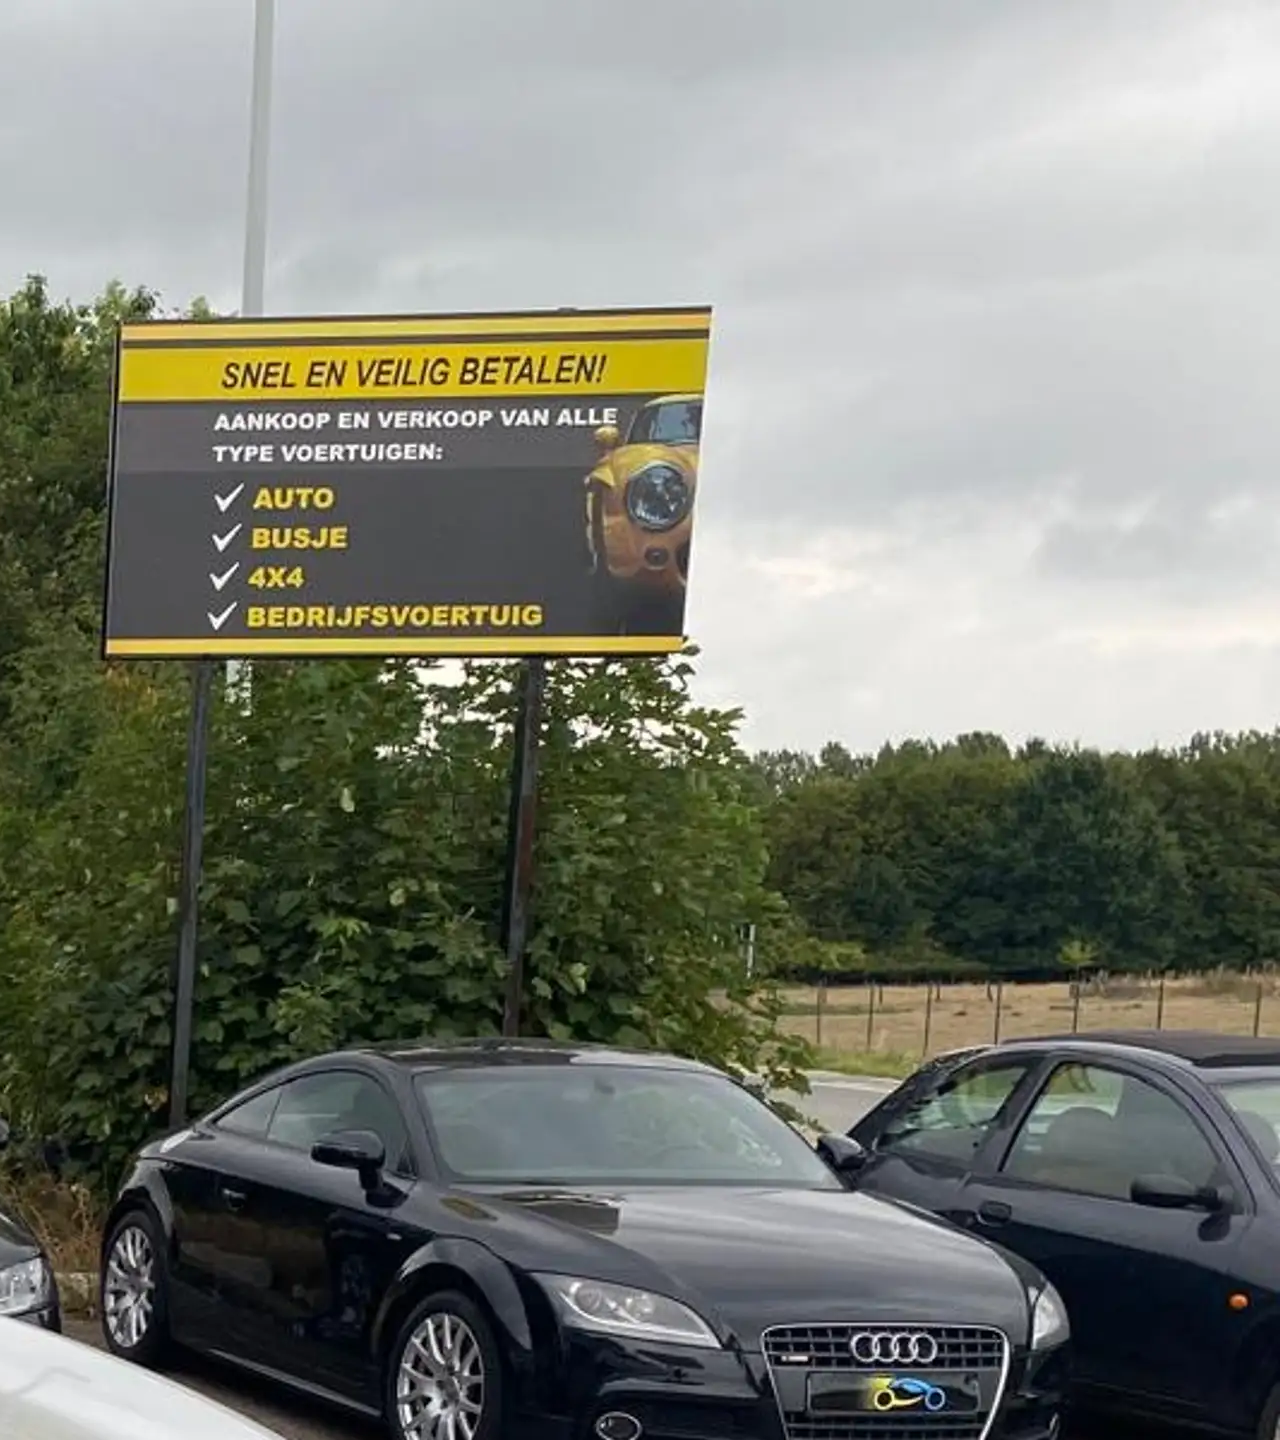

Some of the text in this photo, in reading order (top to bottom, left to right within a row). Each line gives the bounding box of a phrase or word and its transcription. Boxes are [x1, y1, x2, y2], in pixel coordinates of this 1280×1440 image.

[221, 354, 607, 388] SNEL EN VEILIG BETALEN!
[214, 407, 619, 431] AANKOOP EN VERKOOP VAN ALLE
[212, 443, 443, 462] TYPE VOERTUIGEN:
[253, 487, 335, 509] AUTO
[251, 526, 348, 549] BUSJE
[247, 566, 305, 588] 4X4
[246, 604, 543, 628] BEDRIJFSVOERTUIG
